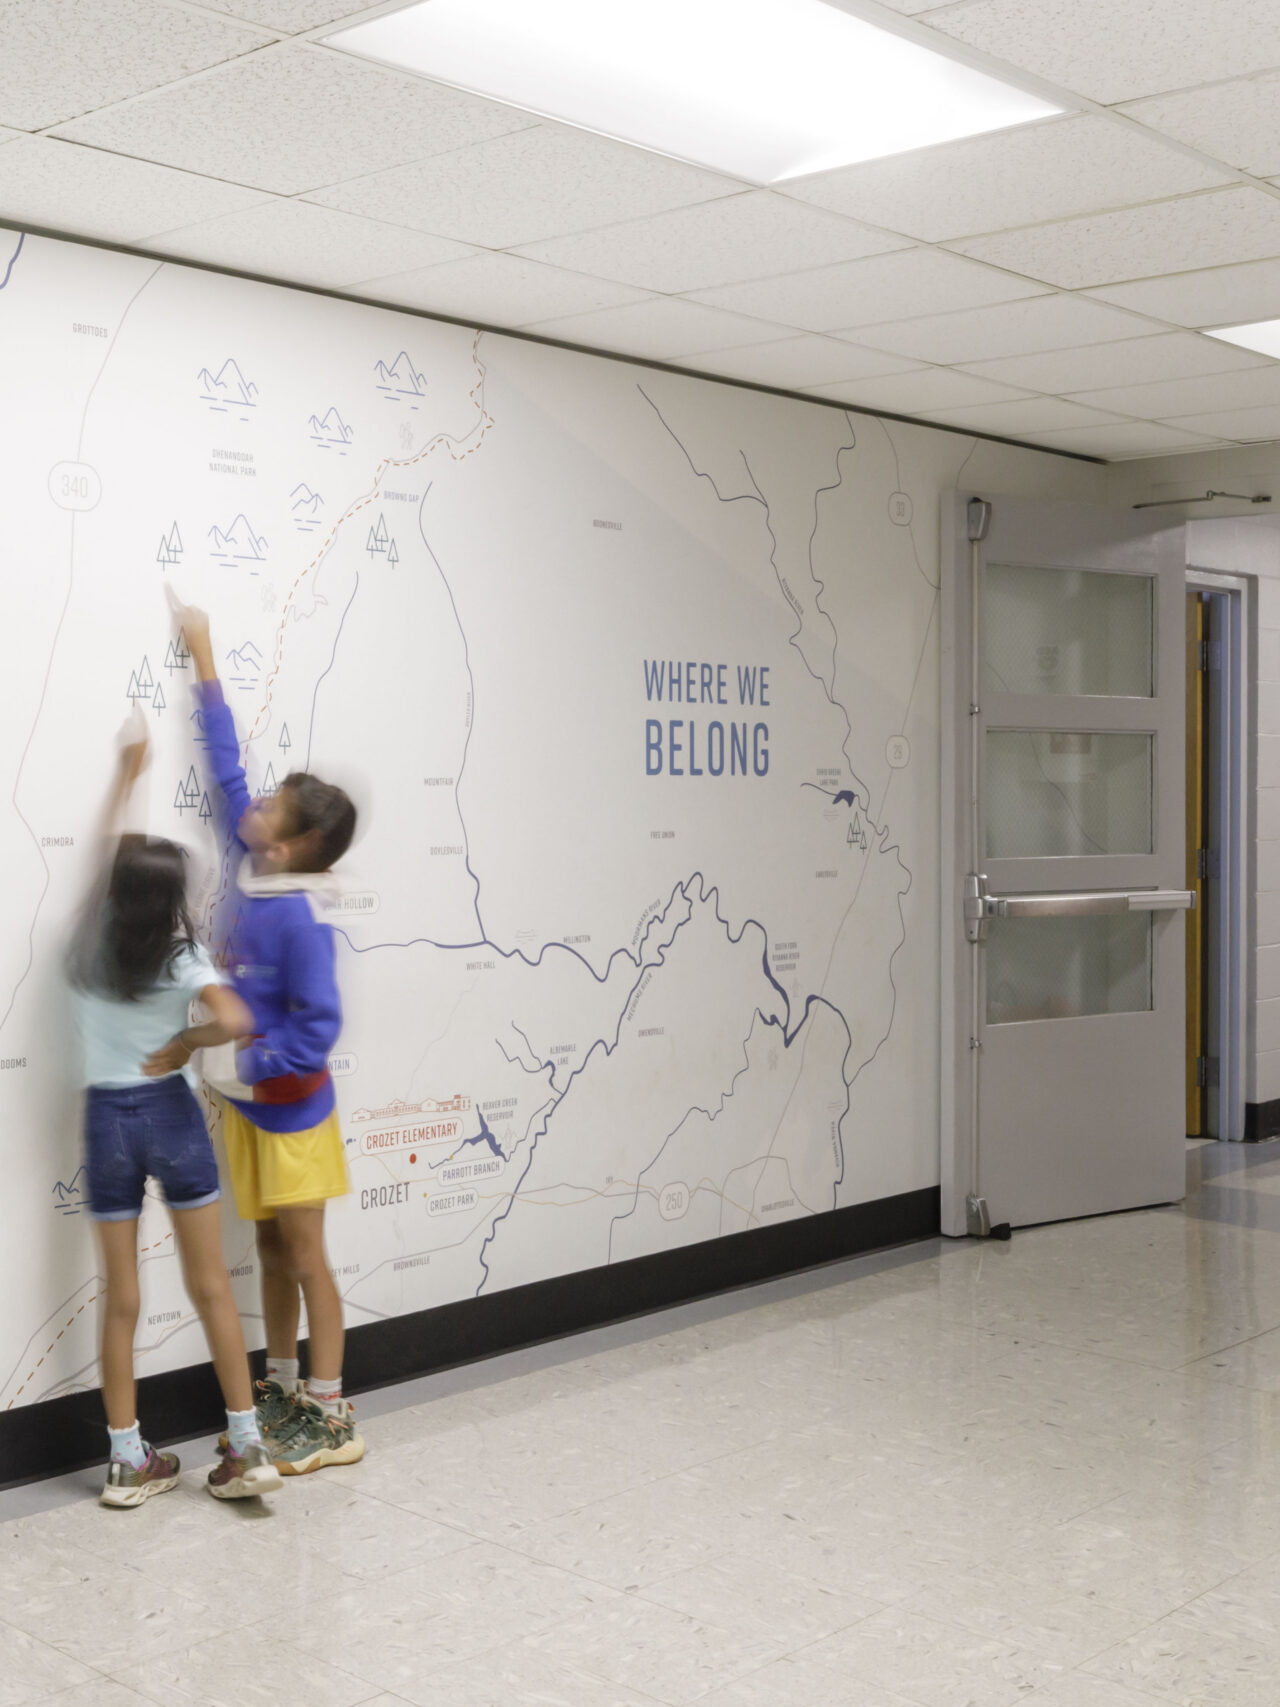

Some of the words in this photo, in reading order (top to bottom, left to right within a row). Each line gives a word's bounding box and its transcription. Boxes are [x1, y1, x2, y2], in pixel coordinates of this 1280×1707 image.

[72, 322, 108, 339] GROTTOES
[209, 462, 238, 474] NATIONAL
[240, 466, 257, 476] PARK
[61, 474, 89, 498] 340
[644, 659, 728, 705] WHERE
[737, 665, 770, 706] WE
[646, 719, 769, 776] BELONG
[41, 836, 75, 848] CRIMORA
[344, 897, 374, 910] HOLLOW
[466, 962, 482, 971] WHITE
[483, 962, 496, 970] HALL
[0, 1056, 27, 1070] DOOMS
[366, 1130, 401, 1150] CROZET
[403, 1122, 458, 1144] ELEMENTARY
[442, 1164, 472, 1182] PARROTT
[474, 1160, 500, 1176] BRANCH
[360, 1182, 411, 1210] CROZET
[430, 1200, 456, 1213] CROZET
[457, 1193, 475, 1206] PARK
[666, 1192, 683, 1212] 250
[343, 1264, 360, 1275] MILLS
[148, 1310, 182, 1326] NEWTOWN
